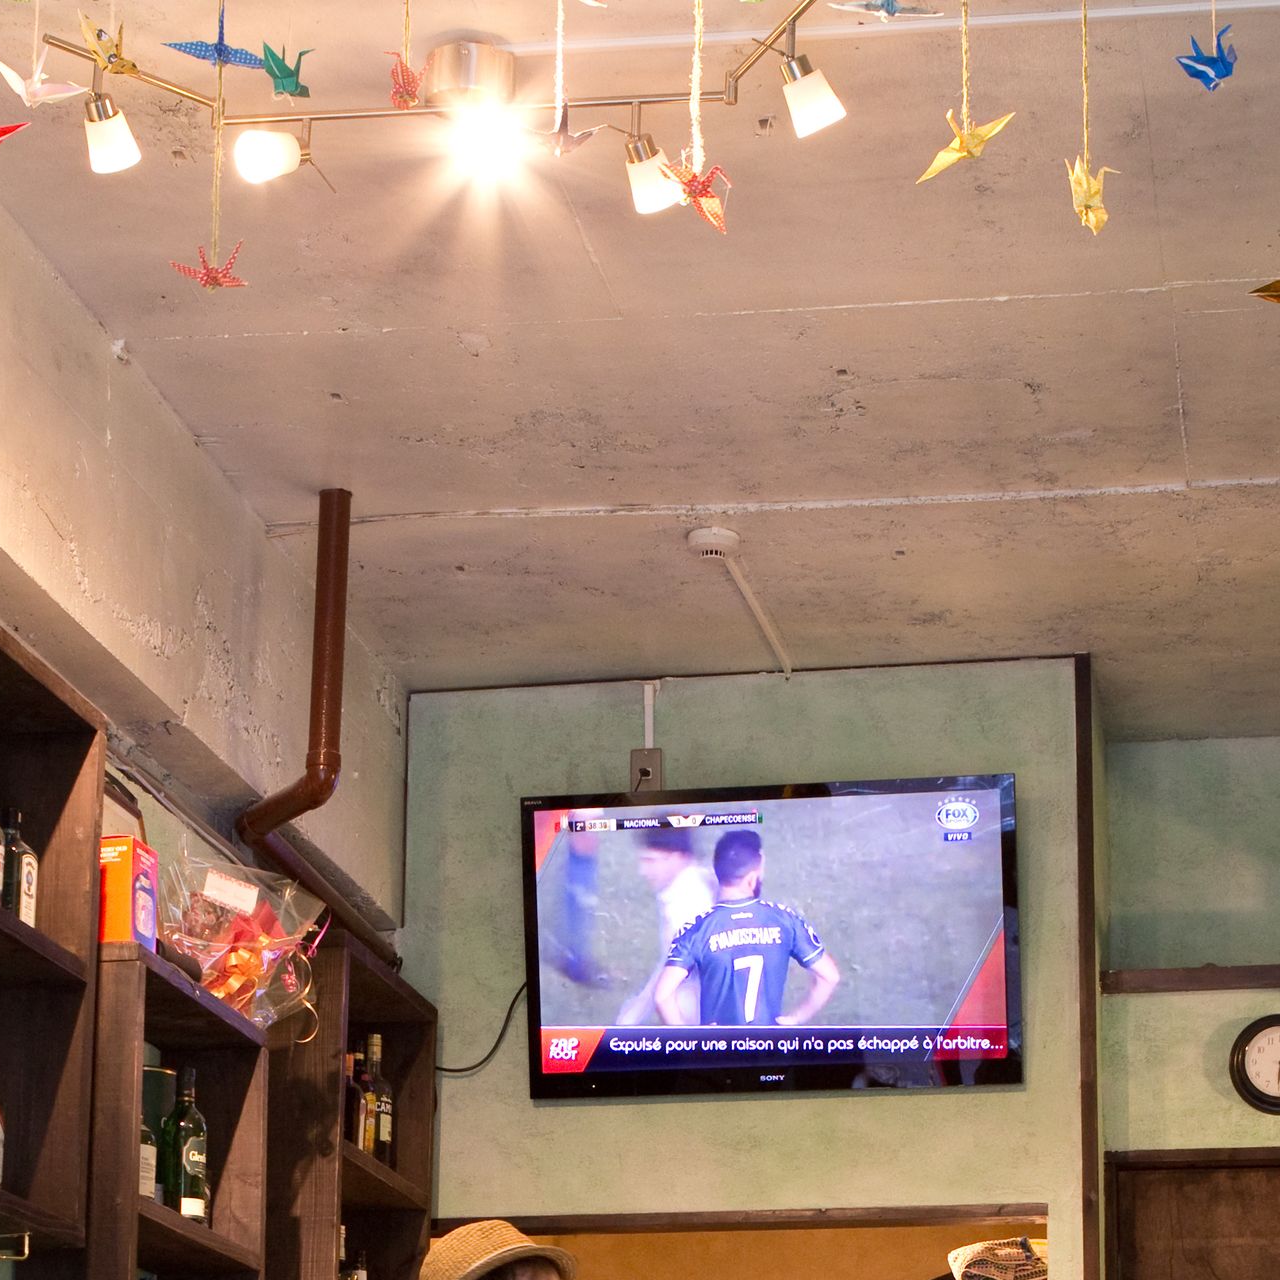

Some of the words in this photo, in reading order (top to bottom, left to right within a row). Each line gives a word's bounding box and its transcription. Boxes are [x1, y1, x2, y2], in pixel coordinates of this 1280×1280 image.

[945, 808, 969, 819] FOX
[623, 818, 661, 829] NACIONAL
[704, 813, 757, 825] CHAPECOENSE
[947, 833, 969, 841] VIVO
[733, 954, 764, 1024] 7
[550, 1037, 579, 1050] ZAP
[609, 1037, 662, 1054] Expulsé
[665, 1040, 698, 1054] pour
[701, 1040, 727, 1051] une
[731, 1037, 773, 1051] raison
[777, 1037, 799, 1053] qui
[803, 1036, 824, 1050] n'a
[827, 1038, 854, 1053] pas
[857, 1036, 919, 1053] échappé
[923, 1036, 933, 1050] à
[549, 1049, 578, 1060] FOOT
[760, 1074, 785, 1082] SONY
